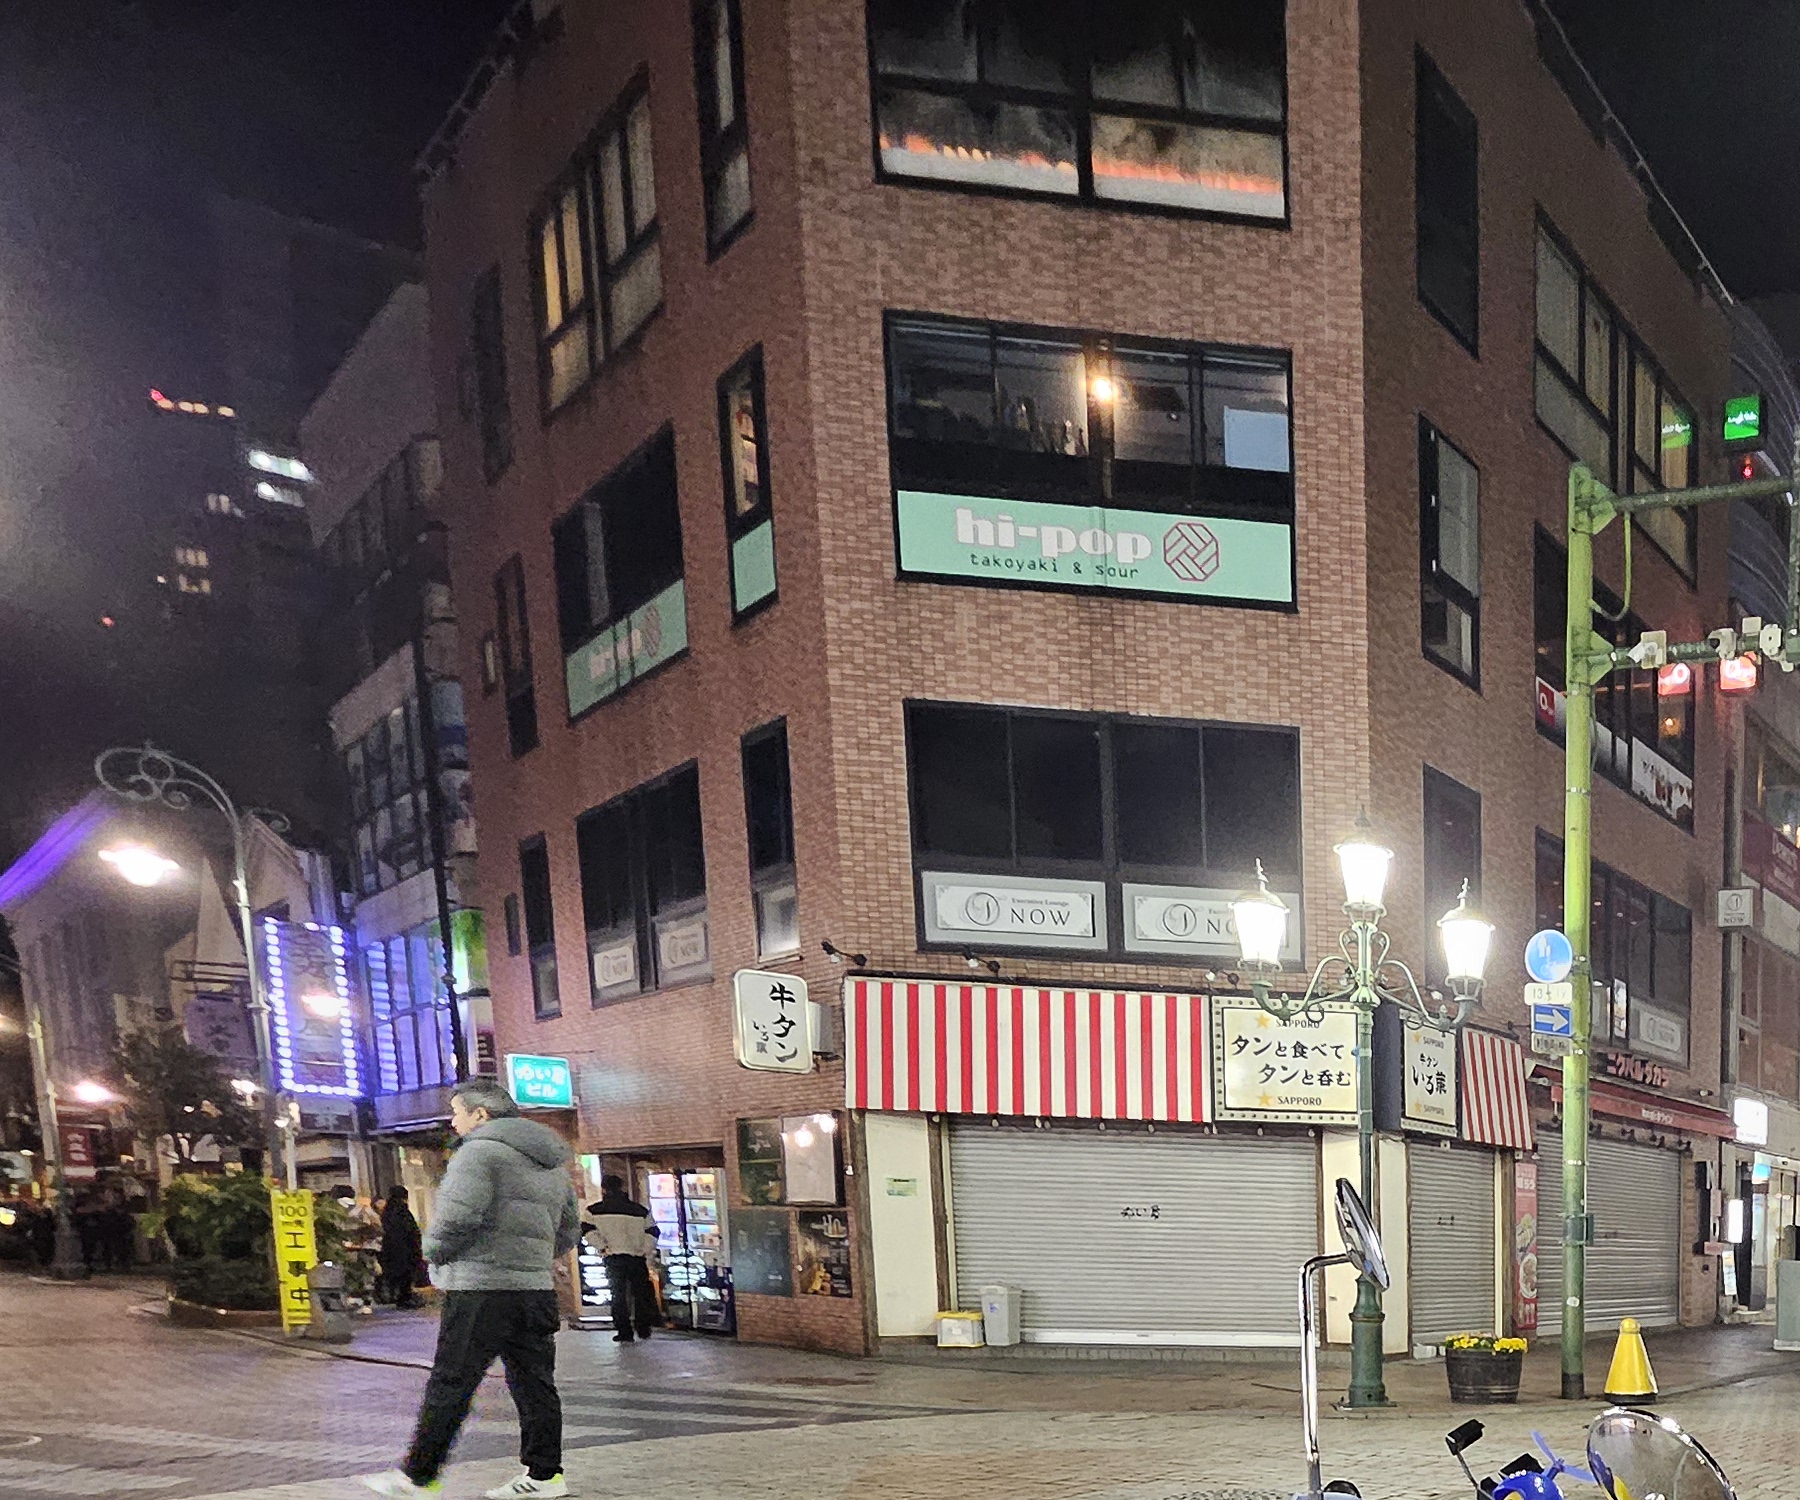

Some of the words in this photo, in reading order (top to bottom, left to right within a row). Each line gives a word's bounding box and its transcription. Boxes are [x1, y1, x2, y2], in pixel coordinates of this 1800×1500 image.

[955, 507, 1152, 564] hi-pop
[970, 553, 1058, 573] takoyaki
[1073, 561, 1083, 574] &
[1096, 565, 1139, 579] sour
[1010, 908, 1071, 927] NOW
[769, 981, 798, 1063] 牛タン
[1231, 1034, 1344, 1059] タンと食べて
[1420, 1053, 1438, 1067] 牛タン
[1259, 1063, 1351, 1086] タンと呑む
[1277, 1096, 1322, 1106] SAPPORO
